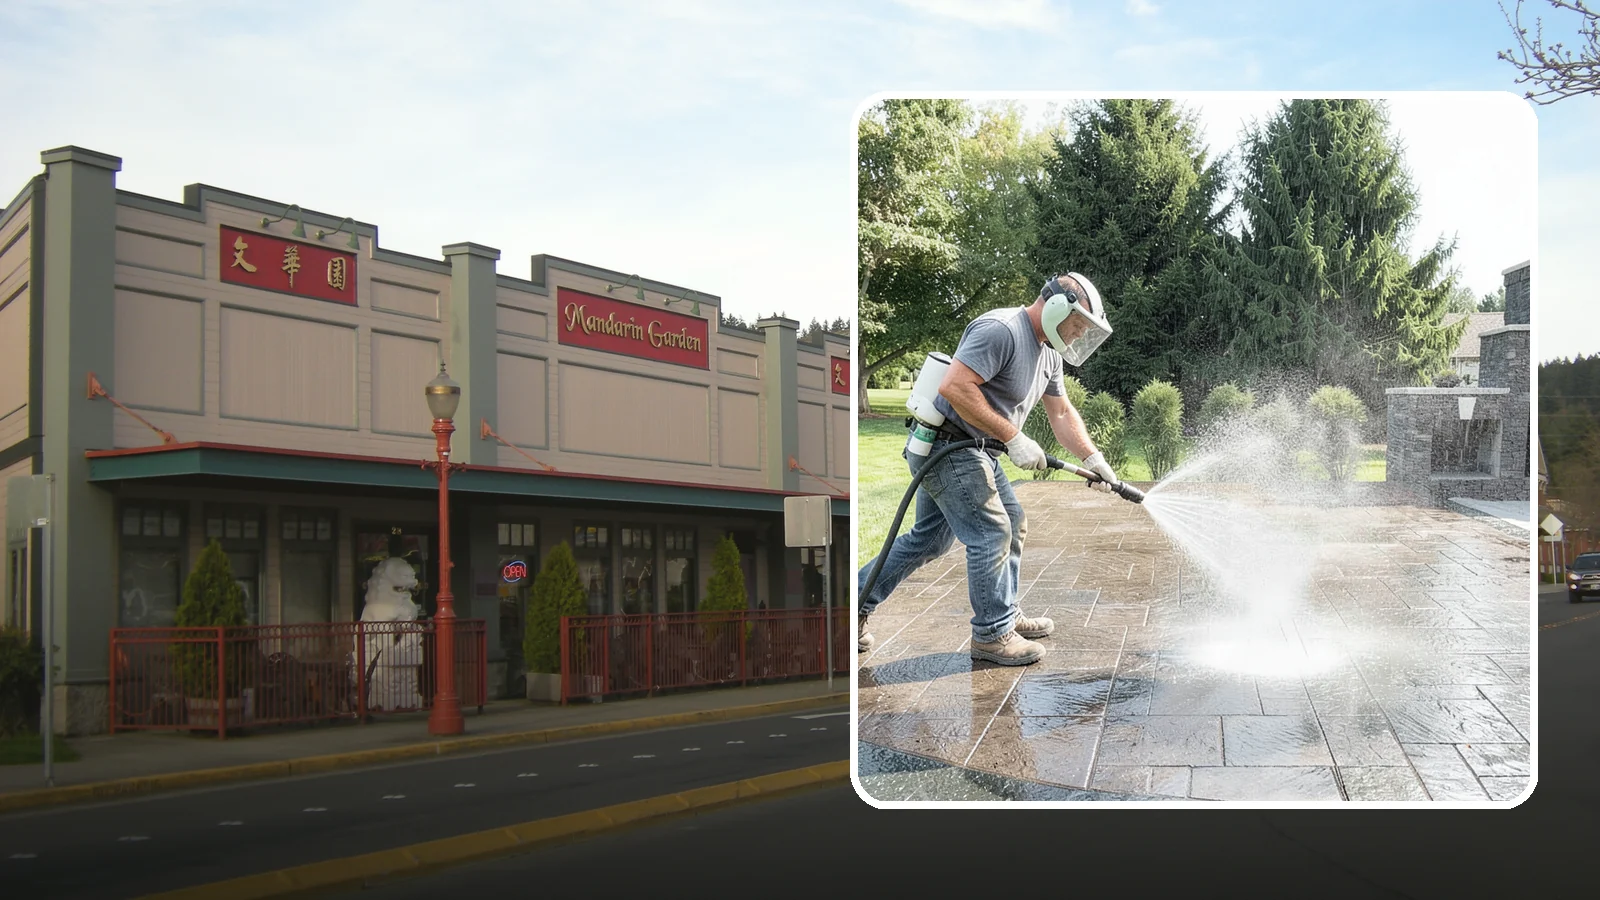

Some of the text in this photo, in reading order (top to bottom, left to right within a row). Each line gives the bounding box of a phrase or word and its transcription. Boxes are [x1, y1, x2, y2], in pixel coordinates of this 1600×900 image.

[230, 235, 347, 291] 文華園
[564, 302, 701, 352] Mandarin Garden
[503, 565, 527, 578] OPEN
